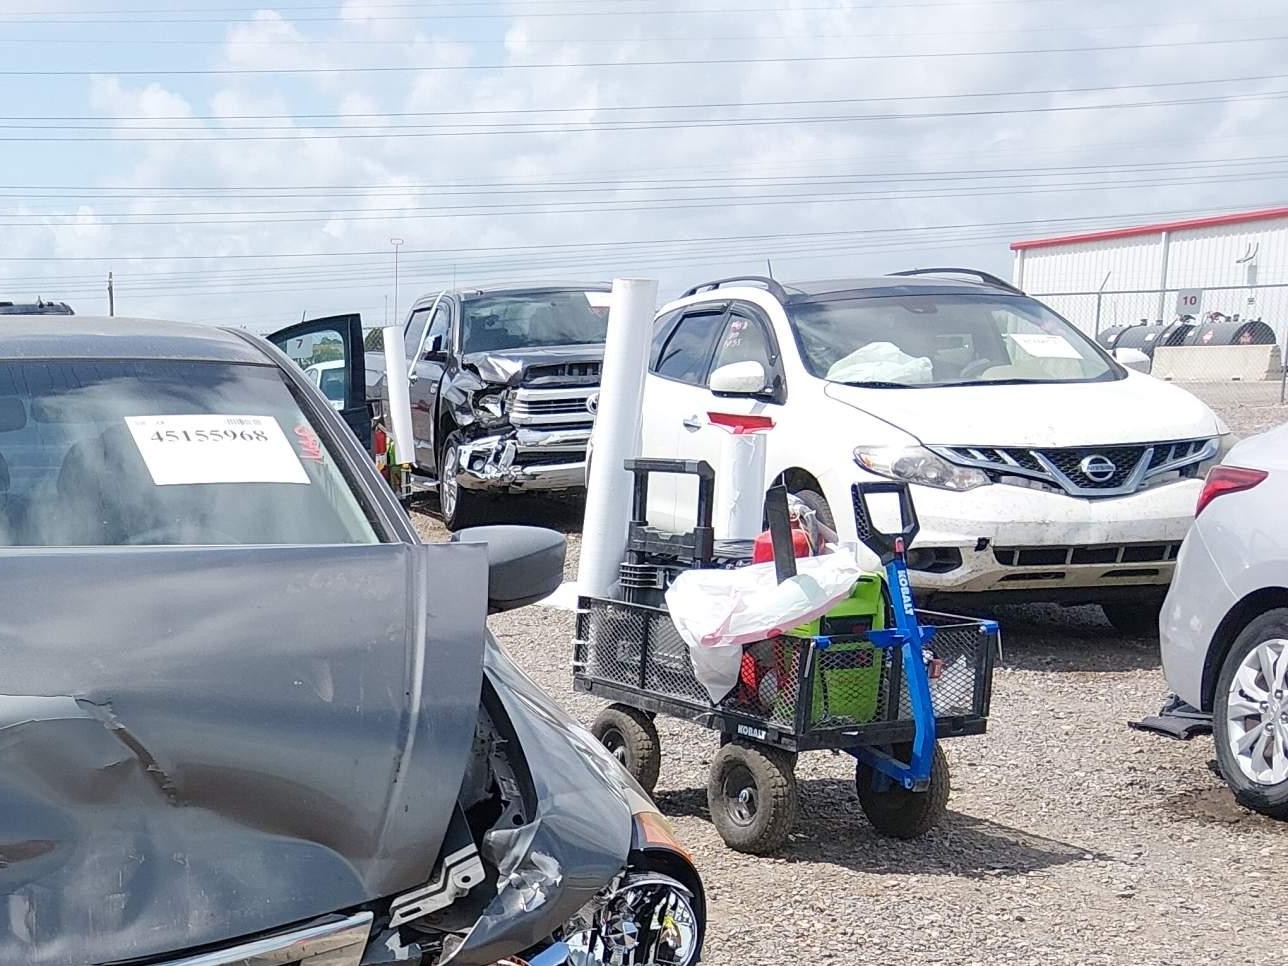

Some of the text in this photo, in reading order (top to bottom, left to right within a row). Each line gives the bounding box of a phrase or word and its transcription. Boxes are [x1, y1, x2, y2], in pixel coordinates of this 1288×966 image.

[1182, 295, 1198, 306] 10
[150, 429, 269, 443] 45155968
[896, 569, 915, 616] KOBALT
[737, 723, 767, 740] KOBALT
